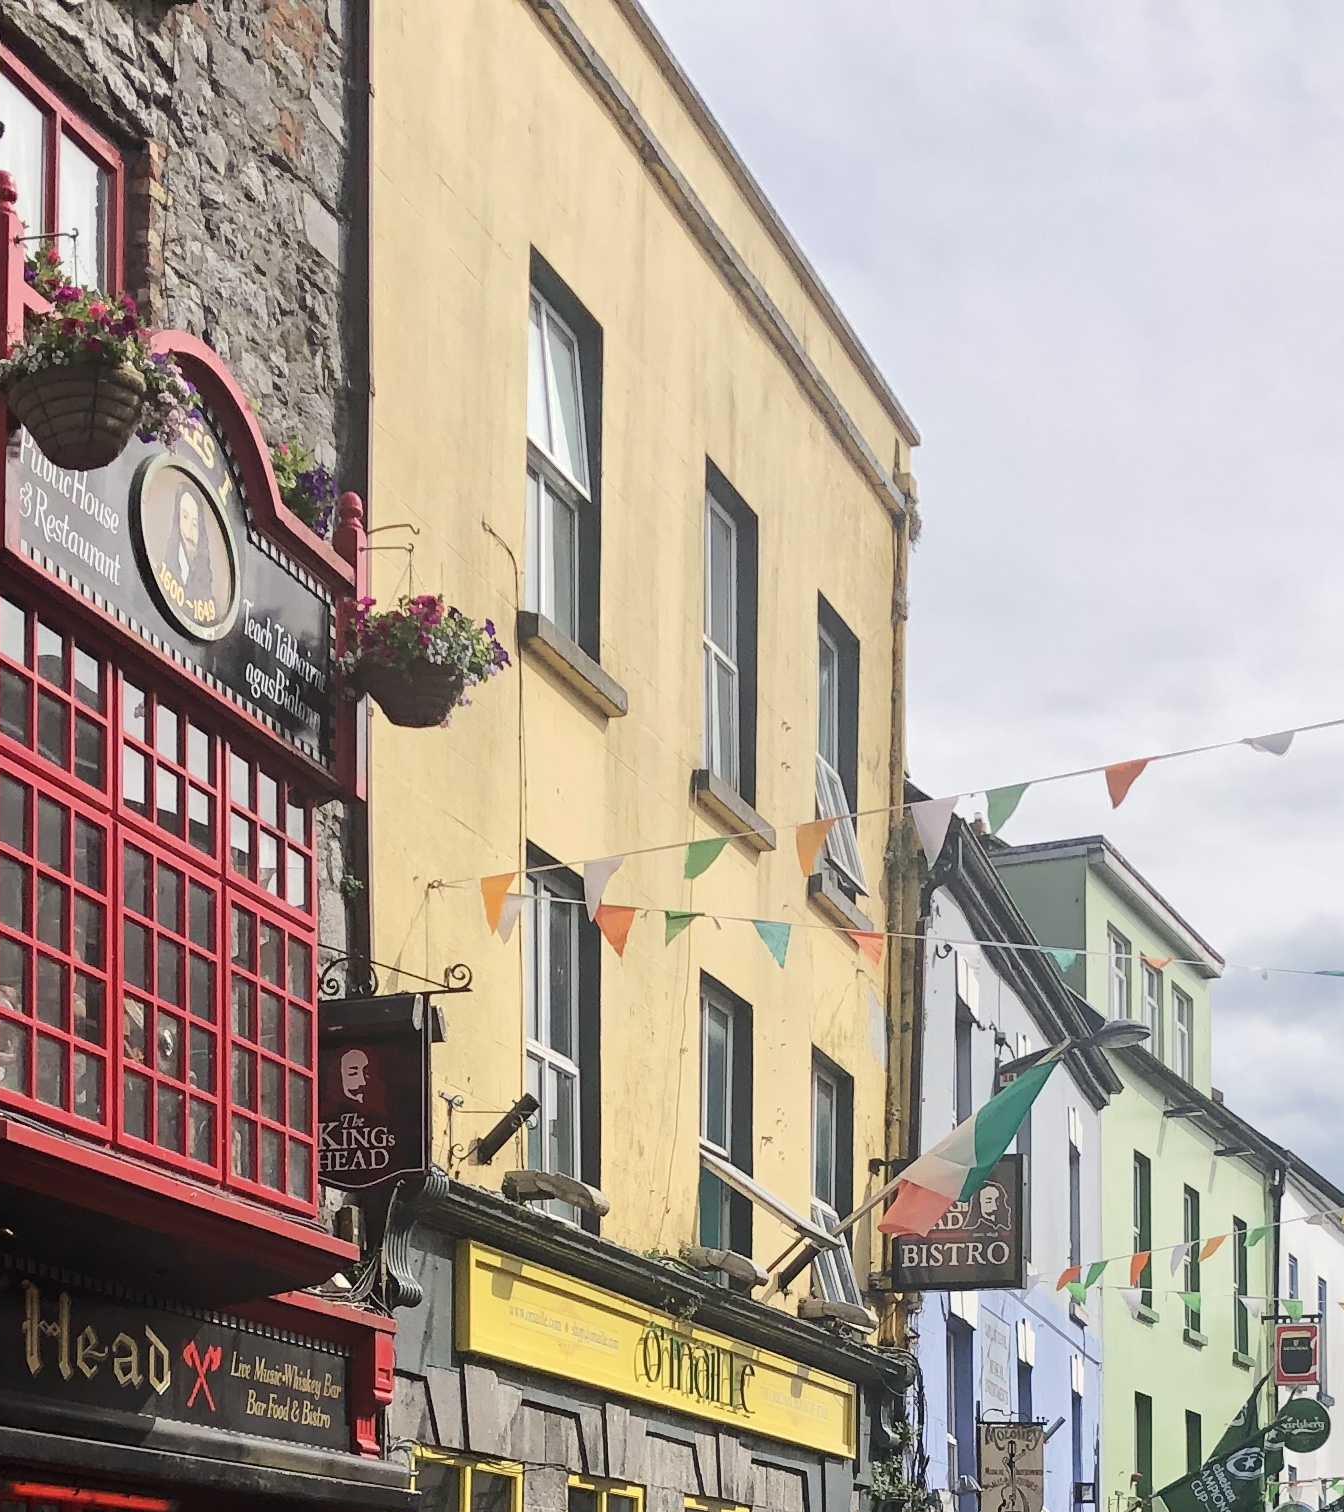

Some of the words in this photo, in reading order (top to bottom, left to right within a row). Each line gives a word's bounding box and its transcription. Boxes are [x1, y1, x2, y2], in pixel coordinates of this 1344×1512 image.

[71, 470, 120, 535] House
[34, 487, 123, 586] Restaurant
[340, 1112, 365, 1128] The
[317, 1148, 390, 1172] HEAD
[901, 1241, 1010, 1268] BISTRO
[20, 1278, 172, 1397] Head
[230, 1351, 252, 1380] Live
[323, 1373, 343, 1399] Bar
[245, 1389, 267, 1417] Bar
[267, 1393, 290, 1422] Food
[290, 1400, 300, 1423] &
[300, 1400, 331, 1429] Bistro
[1190, 1480, 1209, 1503] CUP
[1209, 1457, 1237, 1503] eineken
